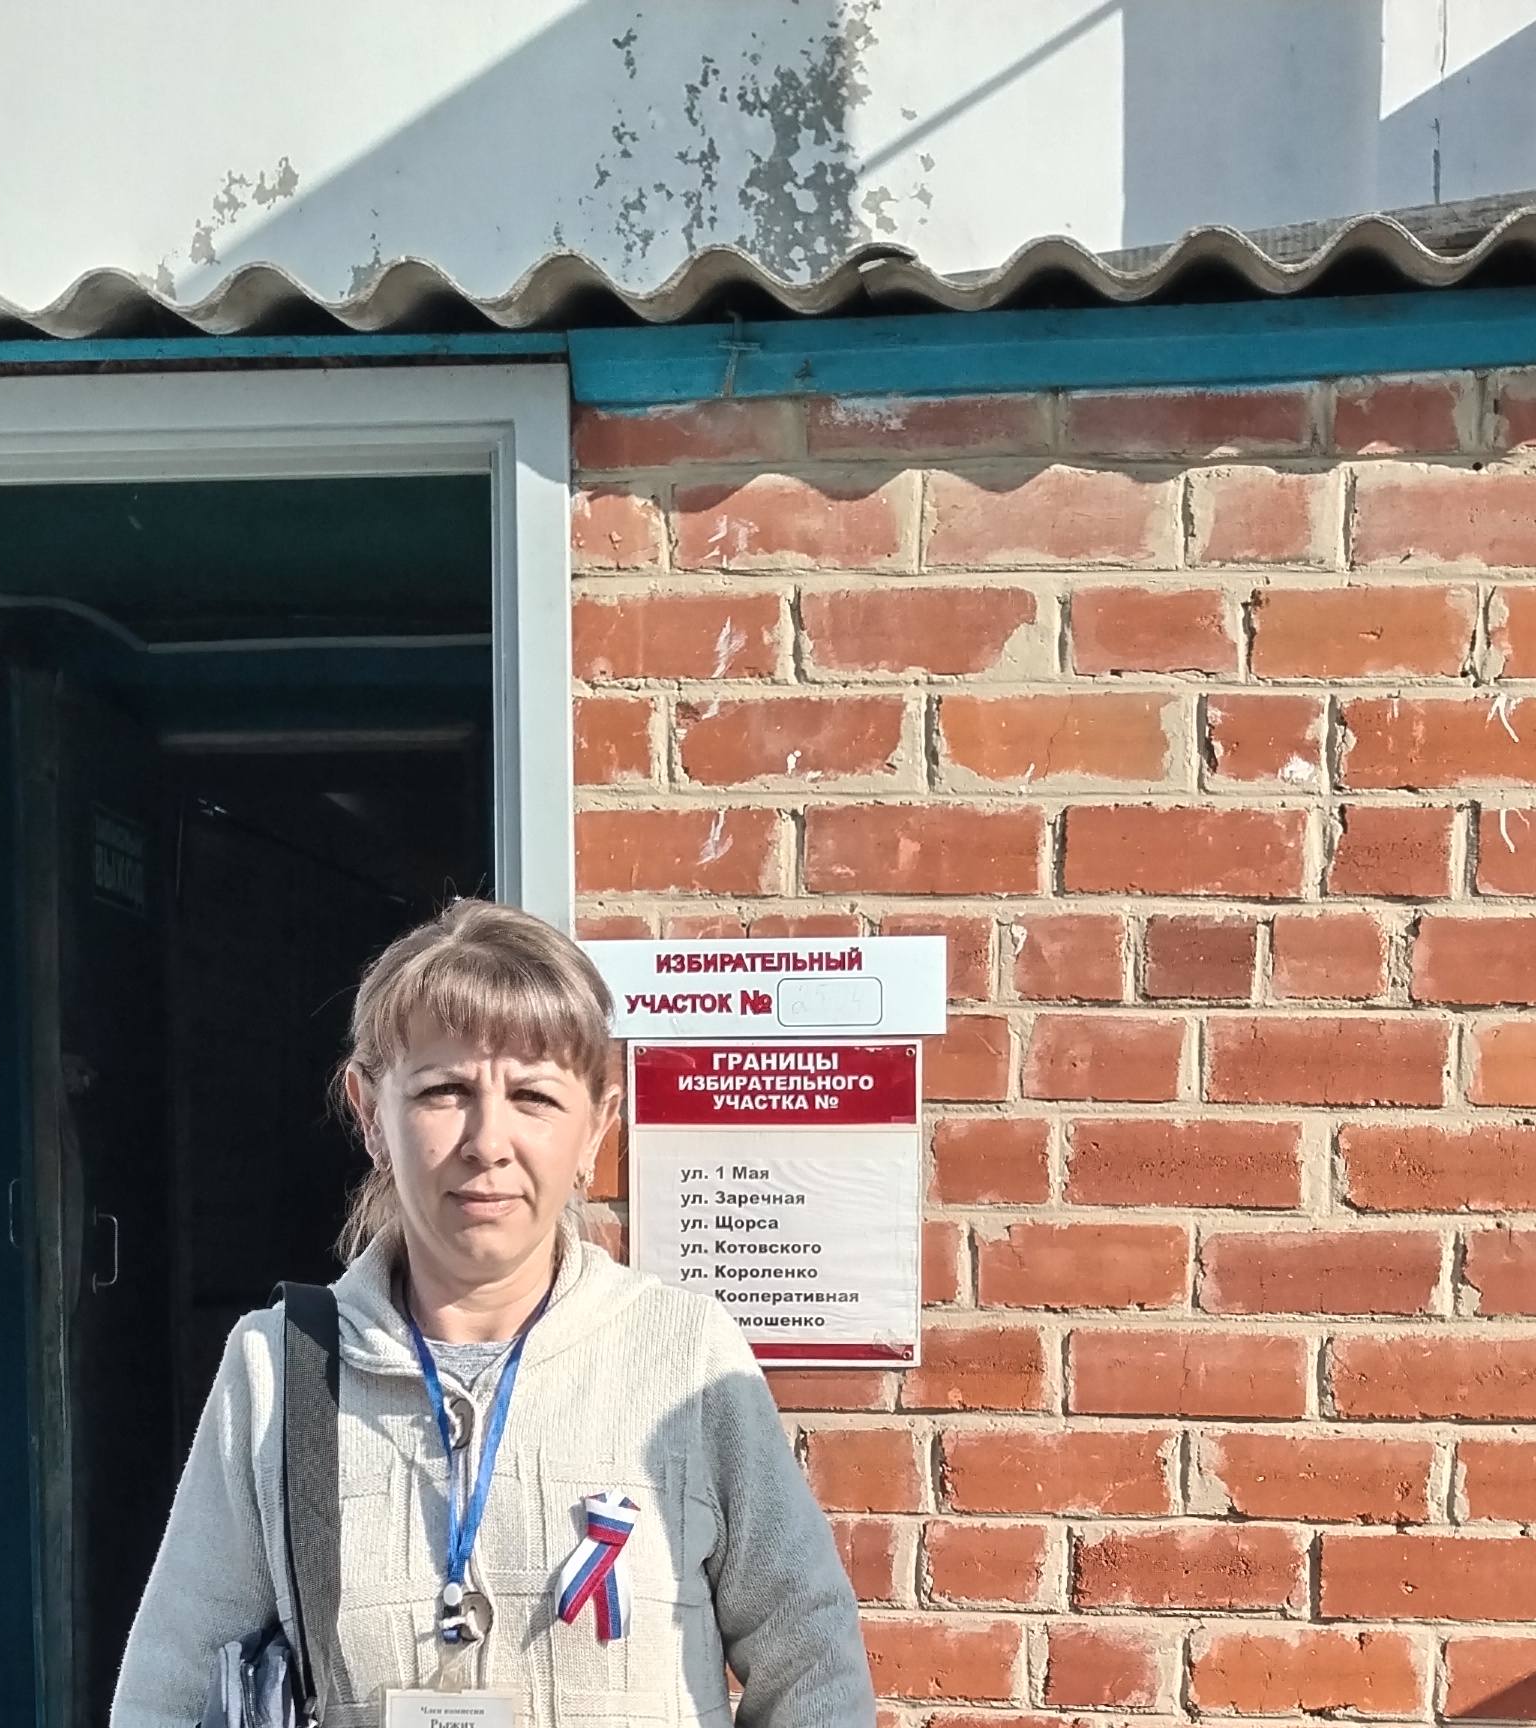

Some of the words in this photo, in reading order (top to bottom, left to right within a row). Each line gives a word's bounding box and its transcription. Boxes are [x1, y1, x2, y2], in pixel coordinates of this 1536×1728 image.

[655, 946, 864, 974] ИЗБИРАТЕЛЬНЫЙ
[625, 992, 732, 1015] УЧАСТОК
[740, 990, 773, 1015] №
[712, 1053, 839, 1074] ГРАНИЦЫ
[678, 1075, 875, 1091] ИЗБИРАТЕЛЬНОГО
[712, 1094, 809, 1111] УЧАСТКА
[814, 1094, 840, 1110] №
[679, 1168, 709, 1183] ул.
[715, 1165, 725, 1180] 1
[732, 1166, 770, 1181] Мая
[679, 1193, 709, 1208] ул.
[714, 1190, 806, 1208] Заречная
[679, 1218, 709, 1233] ул.
[714, 1215, 780, 1233] Щорса
[679, 1242, 709, 1257] ул.
[714, 1239, 822, 1255] Котовского
[679, 1267, 709, 1282] ул.
[714, 1264, 819, 1282] Короленко
[714, 1289, 860, 1305] Кооперативная
